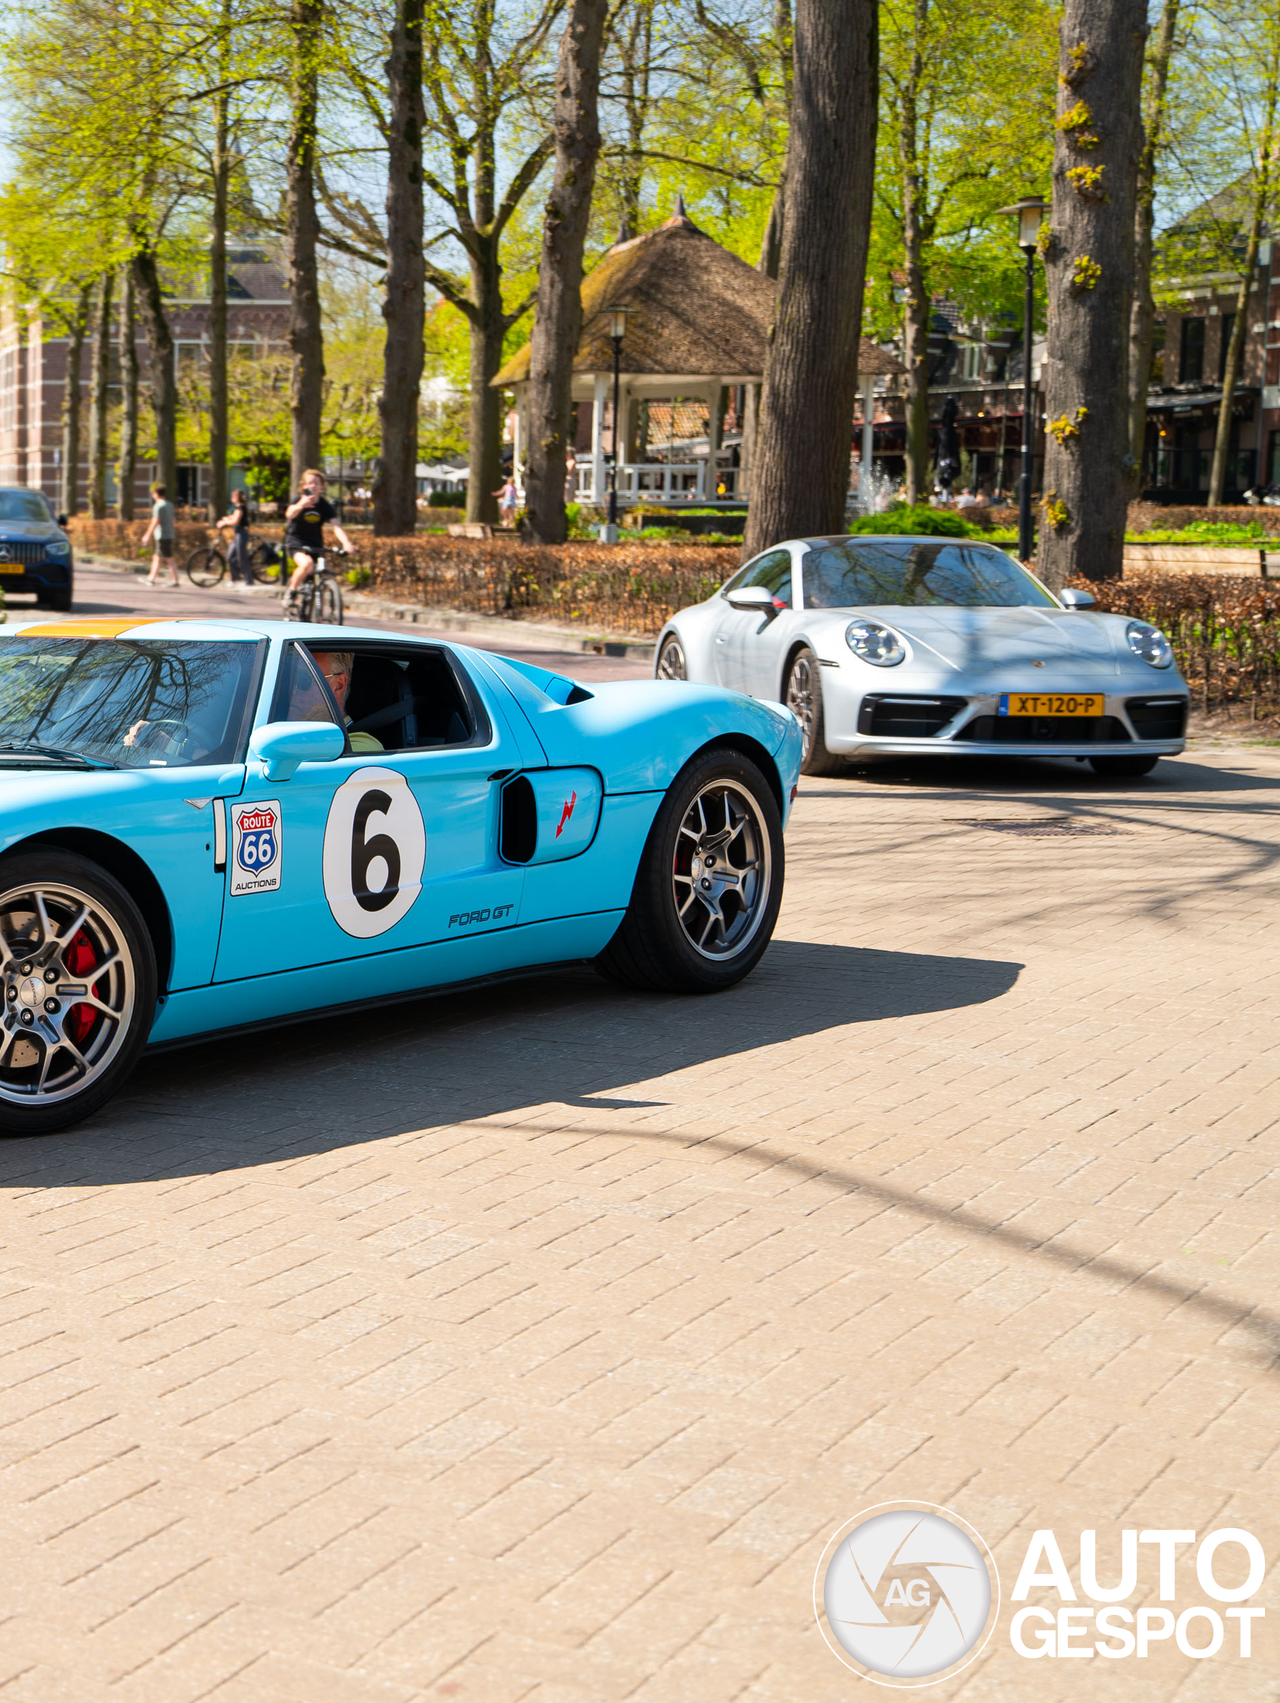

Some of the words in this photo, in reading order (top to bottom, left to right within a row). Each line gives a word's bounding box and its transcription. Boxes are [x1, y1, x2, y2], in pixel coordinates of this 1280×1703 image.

[1017, 697, 1095, 713] XT-120-P
[243, 815, 271, 830] ROUTE
[243, 833, 272, 865] 66
[351, 788, 401, 912] 6
[235, 878, 277, 891] AUCTIONS
[448, 908, 491, 928] FORD
[492, 904, 514, 920] GT
